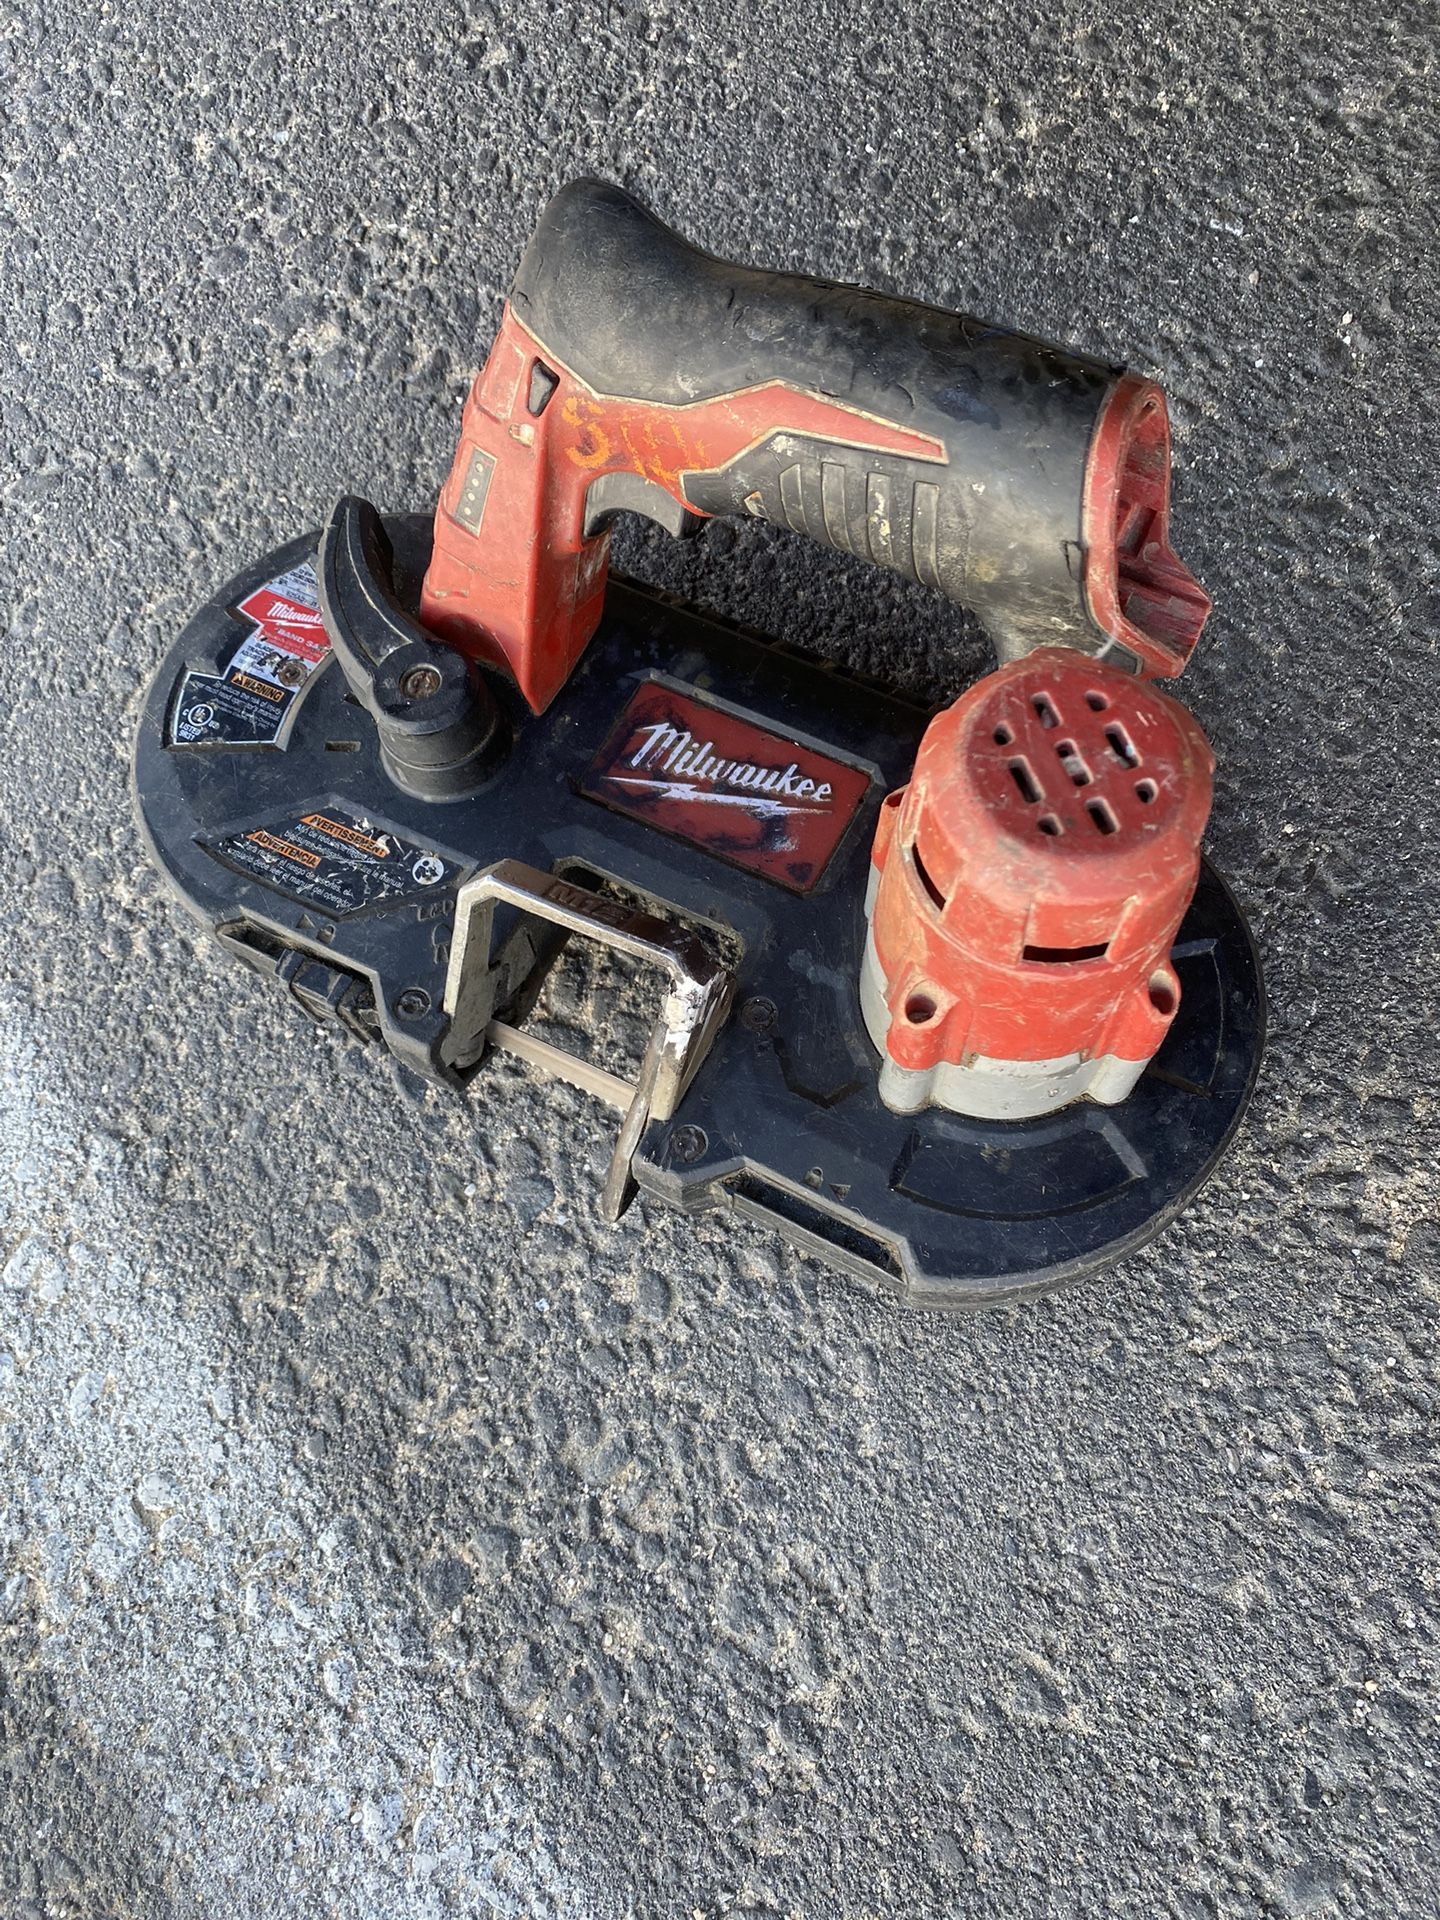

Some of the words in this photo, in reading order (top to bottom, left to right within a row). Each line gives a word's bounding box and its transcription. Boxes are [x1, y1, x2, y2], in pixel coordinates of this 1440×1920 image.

[266, 601, 323, 624] Milwauk
[277, 628, 306, 645] BAND
[243, 677, 283, 702] WARNING
[179, 722, 201, 736] LISTED
[631, 722, 832, 801] Milwaukee
[308, 829, 319, 839] de
[253, 858, 271, 872] debe
[269, 865, 284, 878] leer
[313, 885, 325, 896] del
[279, 858, 288, 867] el
[285, 861, 307, 878] riesgo
